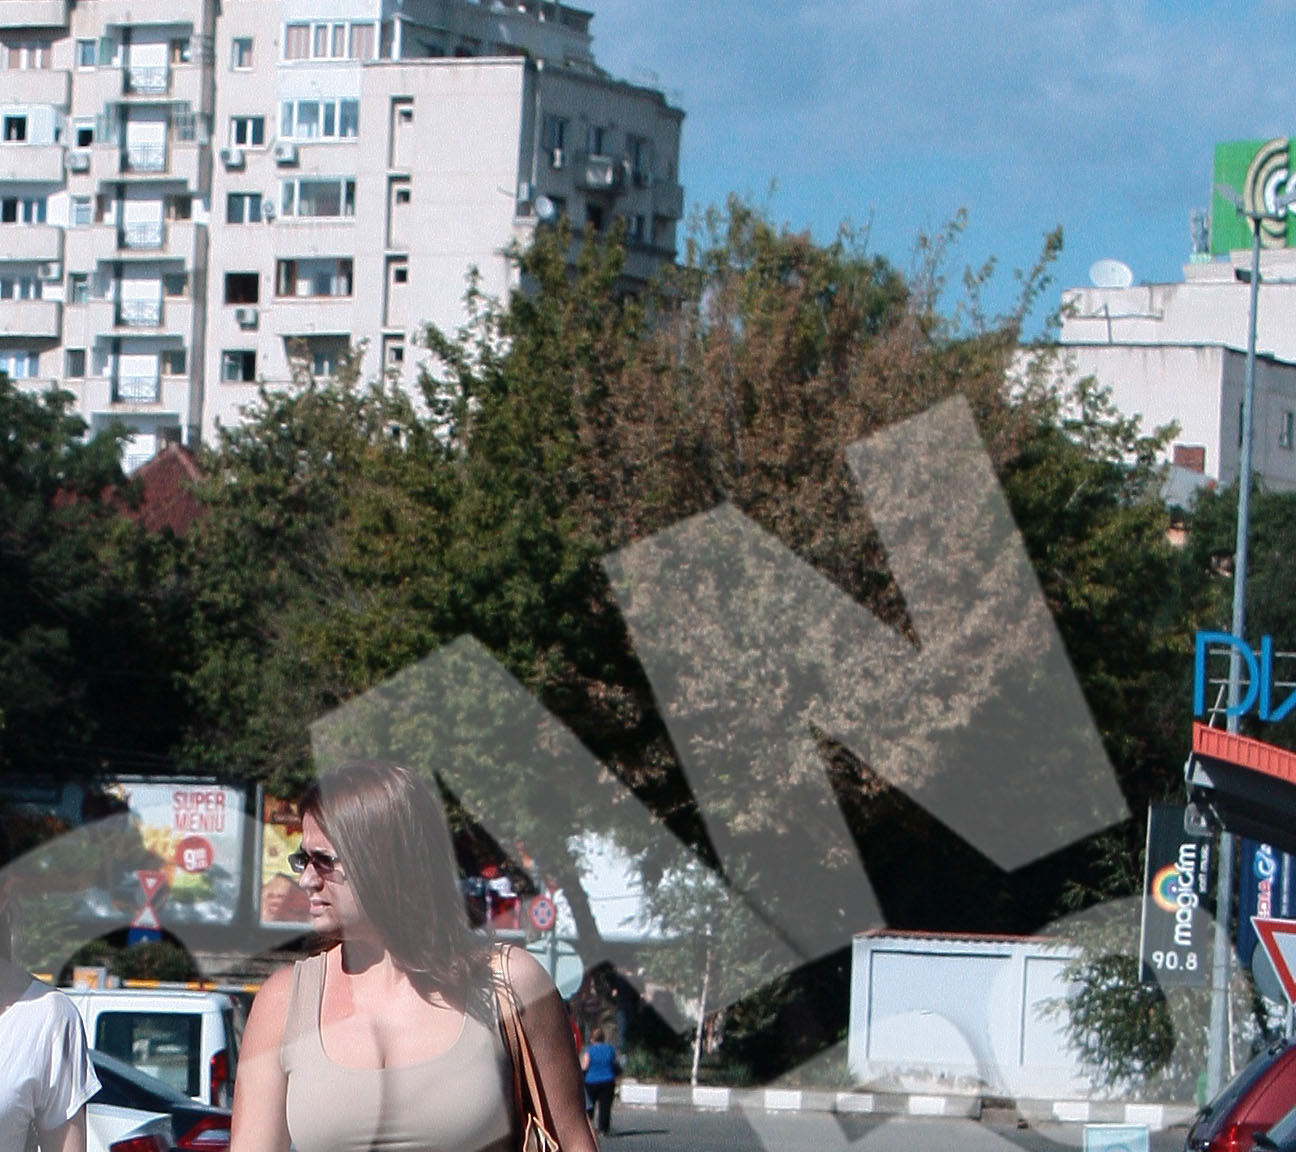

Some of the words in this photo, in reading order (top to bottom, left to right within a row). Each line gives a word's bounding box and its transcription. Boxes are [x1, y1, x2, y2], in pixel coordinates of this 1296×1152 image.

[173, 790, 225, 811] SUPER
[174, 812, 225, 832] MENIU
[1151, 950, 1198, 971] 90.8
